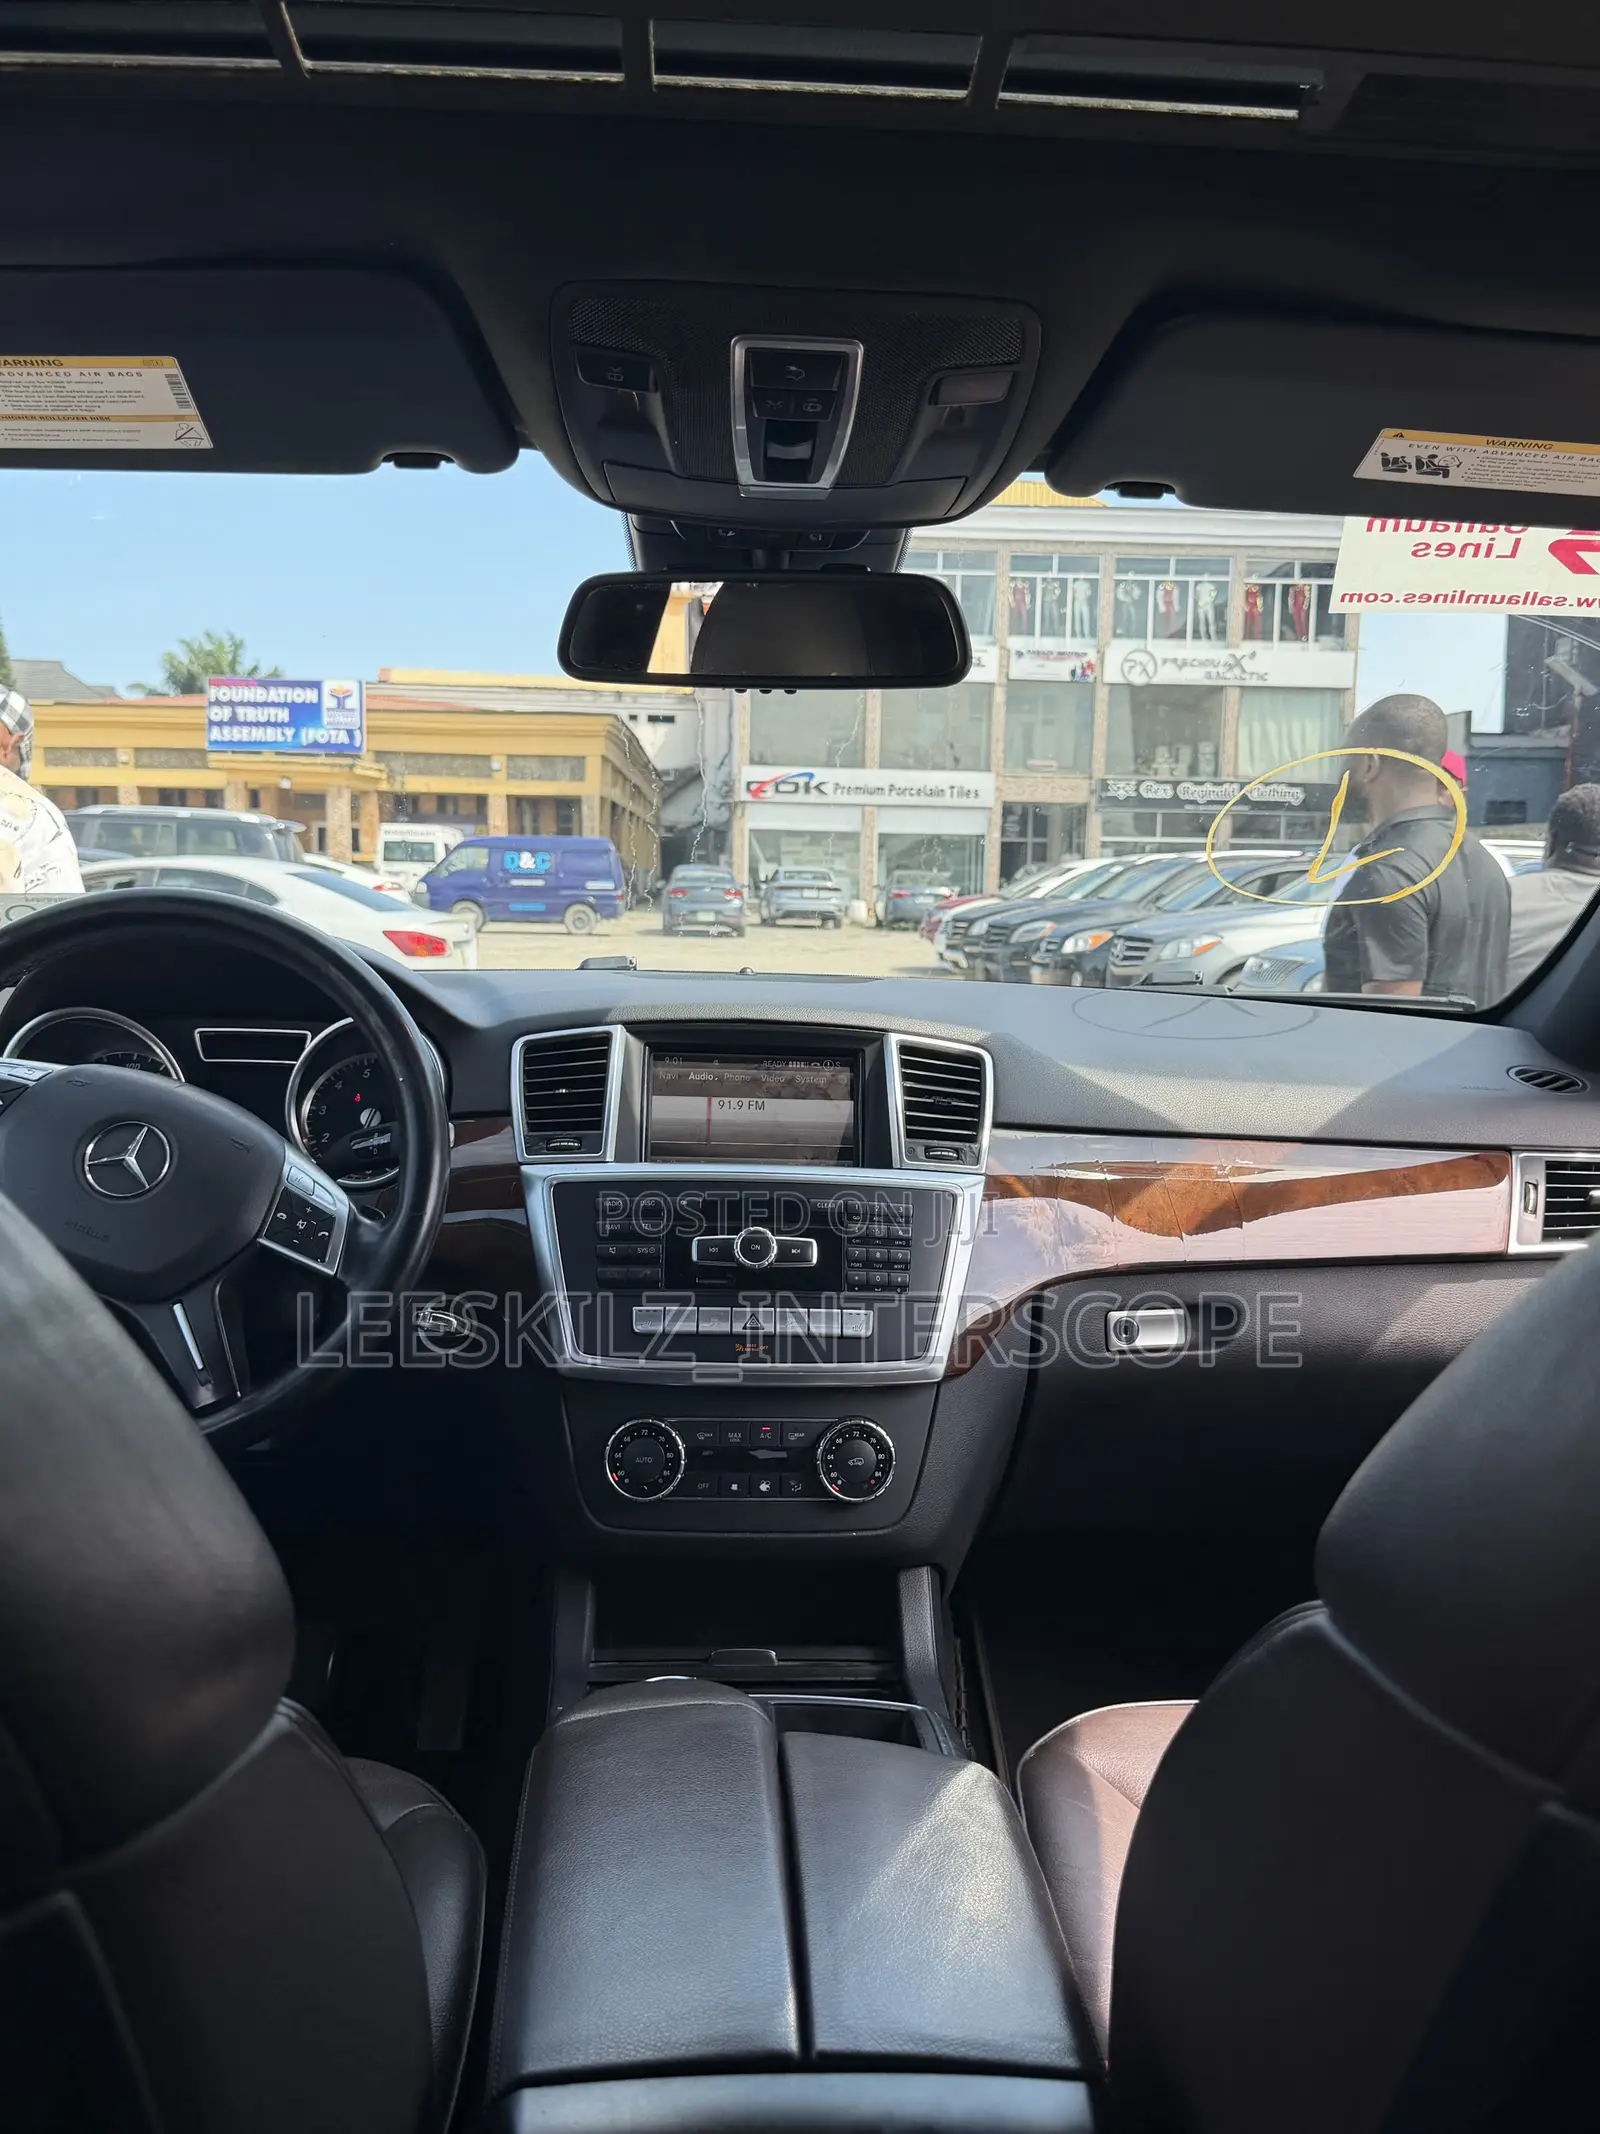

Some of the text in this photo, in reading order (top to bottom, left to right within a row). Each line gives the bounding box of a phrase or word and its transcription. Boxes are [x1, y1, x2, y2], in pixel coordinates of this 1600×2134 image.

[0, 359, 64, 367] ARNING
[1485, 439, 1555, 450] WARNING
[1482, 449, 1548, 459] ADVANCED
[208, 686, 319, 704] FOUNDATION
[208, 705, 290, 723] OF TRUTH
[210, 726, 296, 743] ASSEMBLY
[833, 782, 886, 797] Premium
[888, 784, 946, 798] Porcelain
[948, 786, 979, 799] Tiles
[1139, 781, 1174, 799] Rex
[363, 1069, 371, 1078] 5
[659, 1071, 679, 1079] Navi
[688, 1072, 714, 1081] Audio
[761, 1074, 785, 1082] Video
[795, 1074, 827, 1085] System
[319, 1105, 327, 1115] 3
[718, 1100, 766, 1111] 91.9 FM
[321, 1132, 330, 1143] 2
[697, 1482, 711, 1490] OFF
